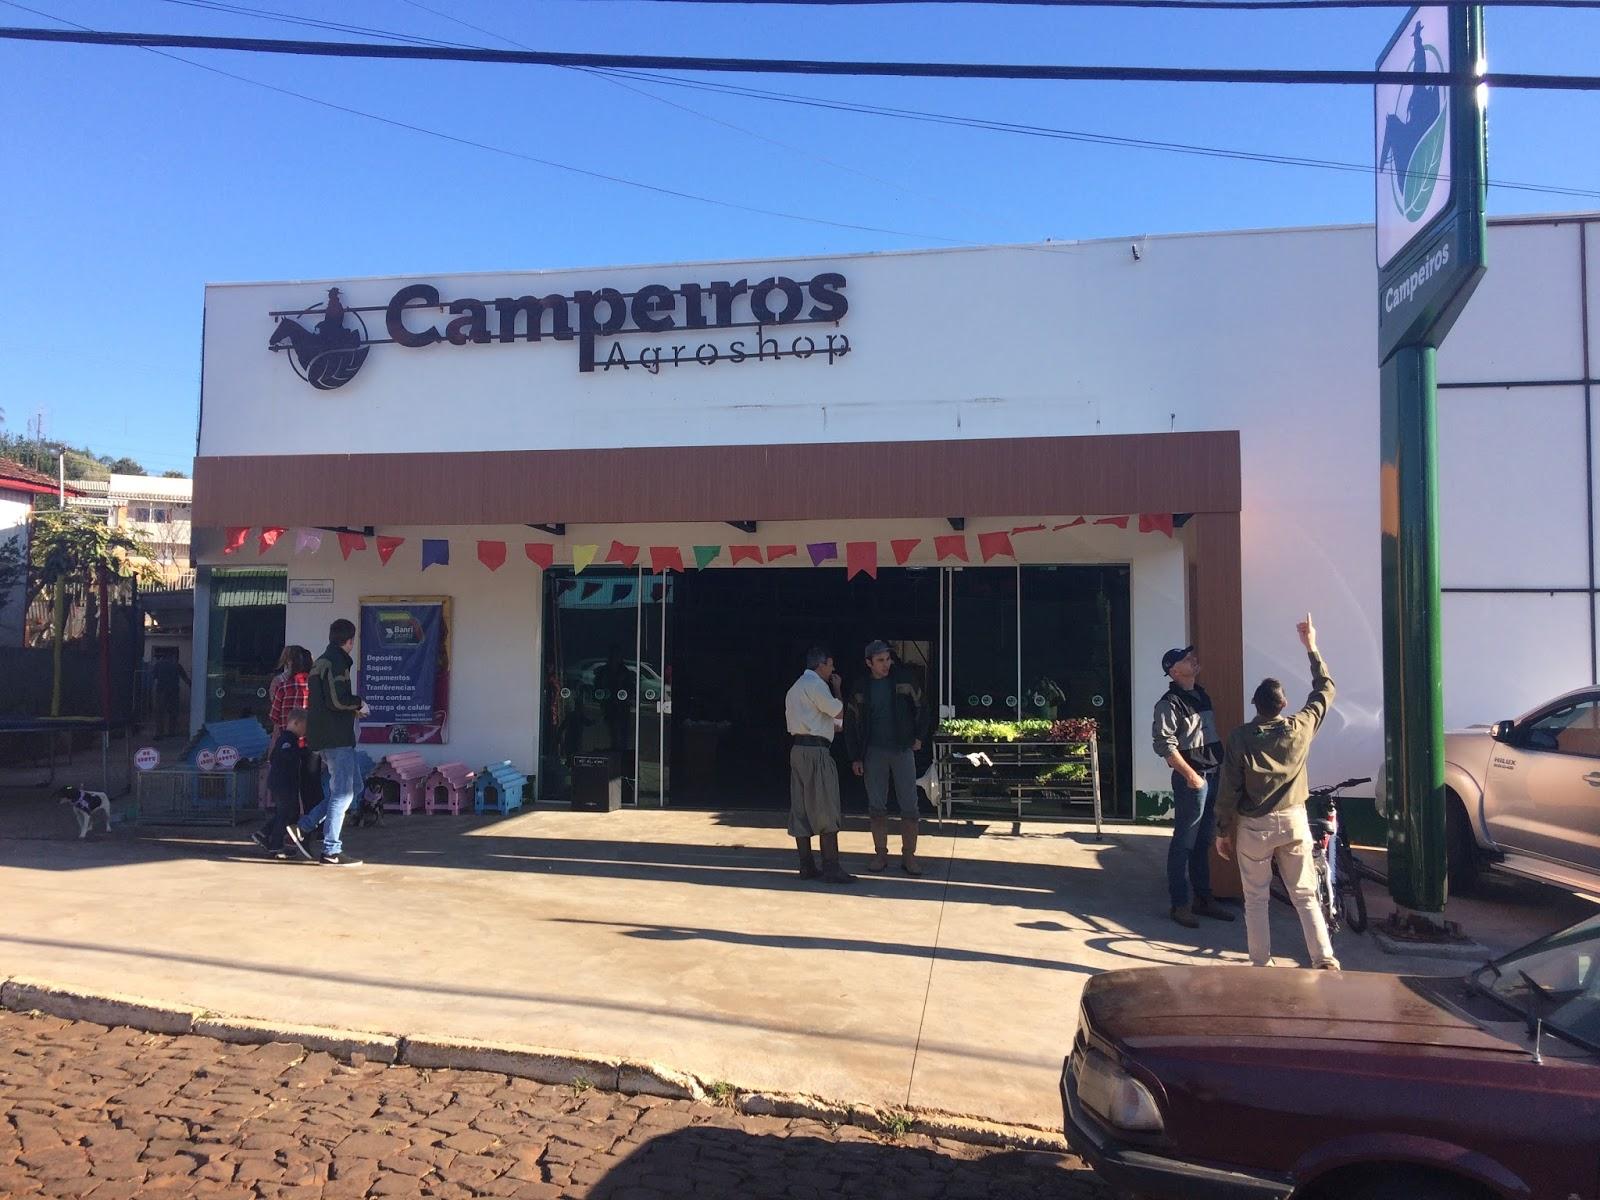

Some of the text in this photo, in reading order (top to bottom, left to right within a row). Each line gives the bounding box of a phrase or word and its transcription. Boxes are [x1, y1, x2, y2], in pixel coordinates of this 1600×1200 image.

[1385, 243, 1449, 313] Campeiros
[386, 272, 849, 373] Campeiros
[603, 325, 850, 375] Agroshop
[394, 625, 414, 633] Banri
[366, 664, 393, 672] Saques
[366, 674, 411, 682] Pagamentos
[1494, 756, 1517, 766] HILUX
